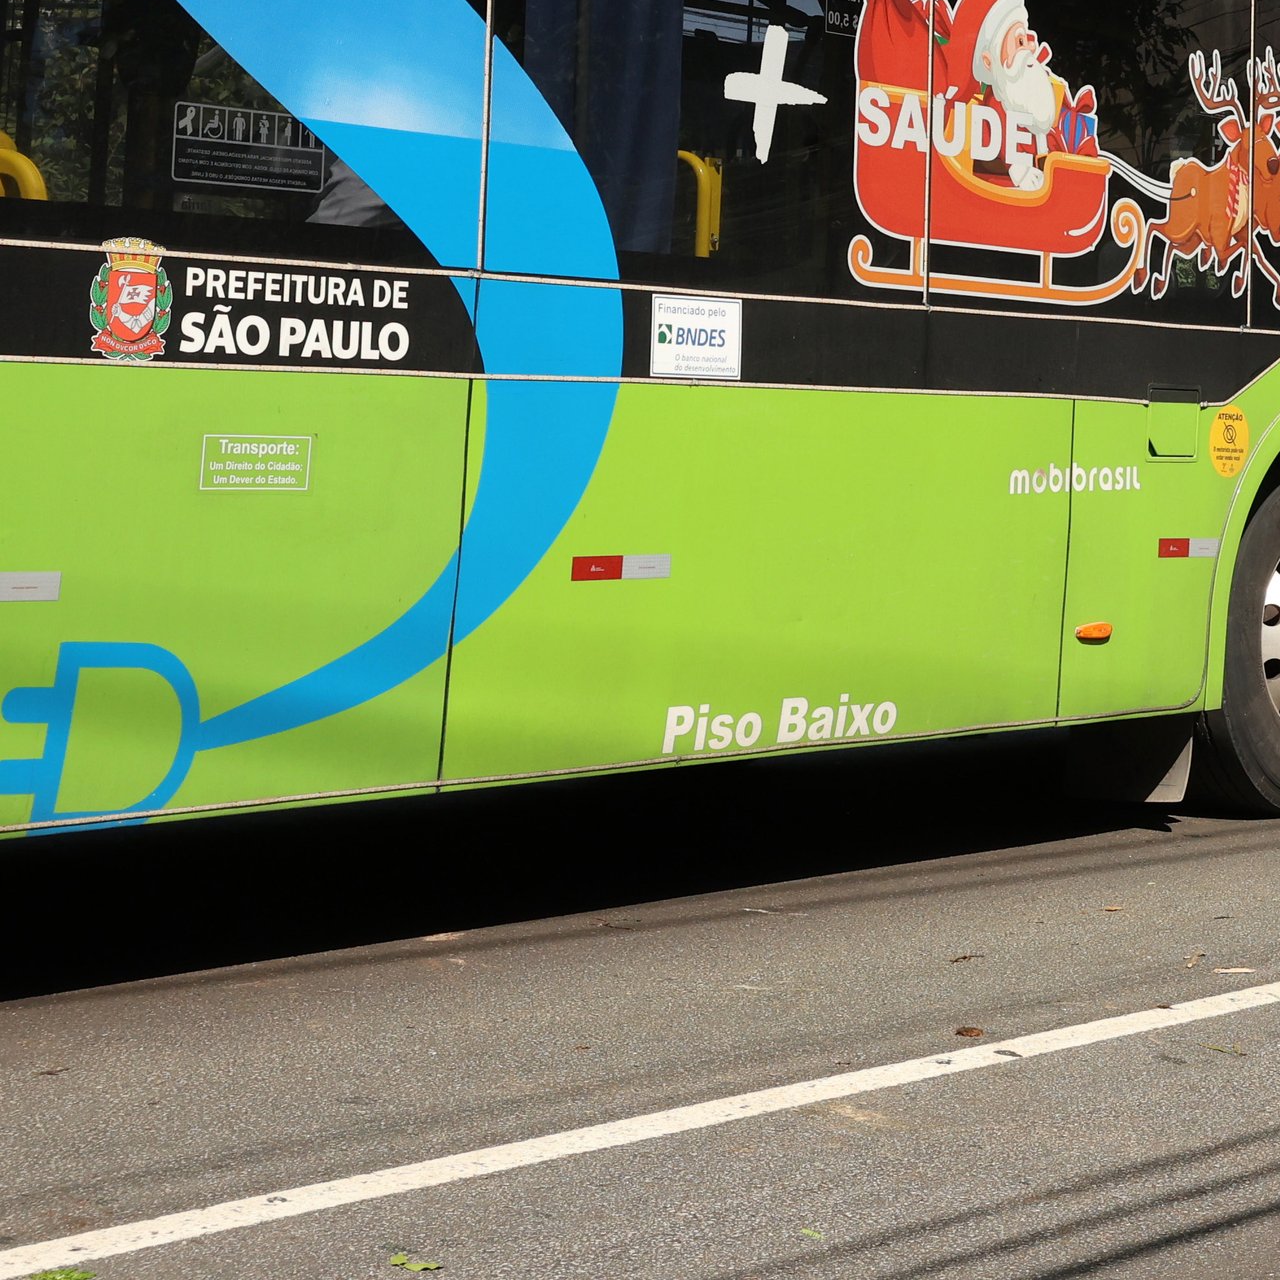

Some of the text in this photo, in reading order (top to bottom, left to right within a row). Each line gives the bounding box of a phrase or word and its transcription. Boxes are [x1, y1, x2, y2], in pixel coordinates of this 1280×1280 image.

[857, 86, 1034, 167] SAÚDE
[185, 266, 410, 310] PREFEITURA DE
[658, 302, 727, 318] Financiado pelo
[101, 335, 115, 347] NON
[179, 304, 410, 361] SÃO PAULO
[675, 327, 726, 348] BNDES
[674, 363, 736, 374] do desenvolvimento
[682, 354, 700, 363] banco
[702, 355, 728, 364] nacional
[219, 439, 300, 458] Transporte:
[209, 461, 223, 471] Um
[225, 461, 253, 471] Direito
[255, 462, 266, 471] do
[213, 475, 299, 485] Um Dever do Estado.
[1009, 462, 1141, 494] mobibrasil
[662, 693, 897, 754] Piso Baixo
